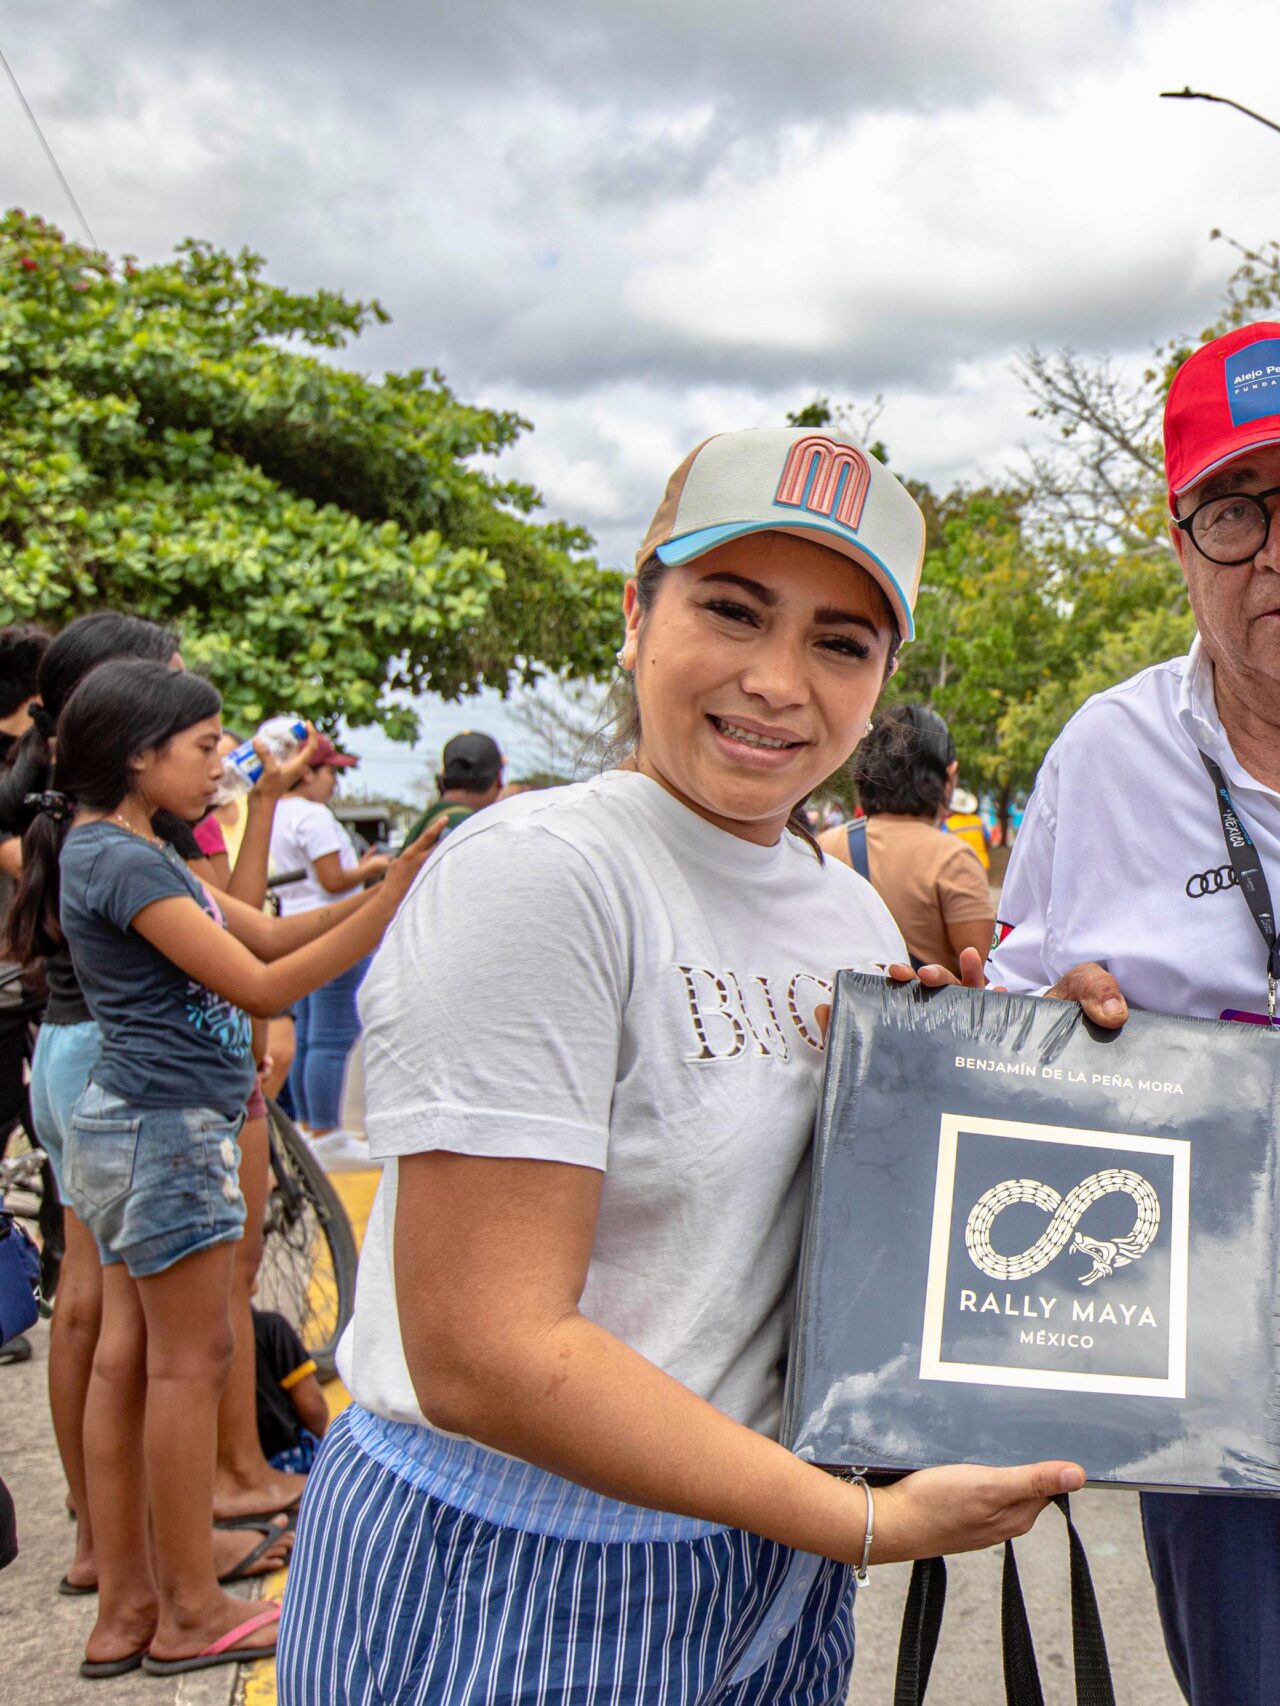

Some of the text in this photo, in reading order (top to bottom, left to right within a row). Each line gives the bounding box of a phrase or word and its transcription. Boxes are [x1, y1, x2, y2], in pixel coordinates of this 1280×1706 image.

[1234, 370, 1263, 384] Alejo
[955, 1056, 1184, 1095] BENJAMÍN DE LA PEÑA MORA
[959, 1289, 1158, 1328] RALLY MAYA
[1019, 1329, 1094, 1349] MÉXICO
